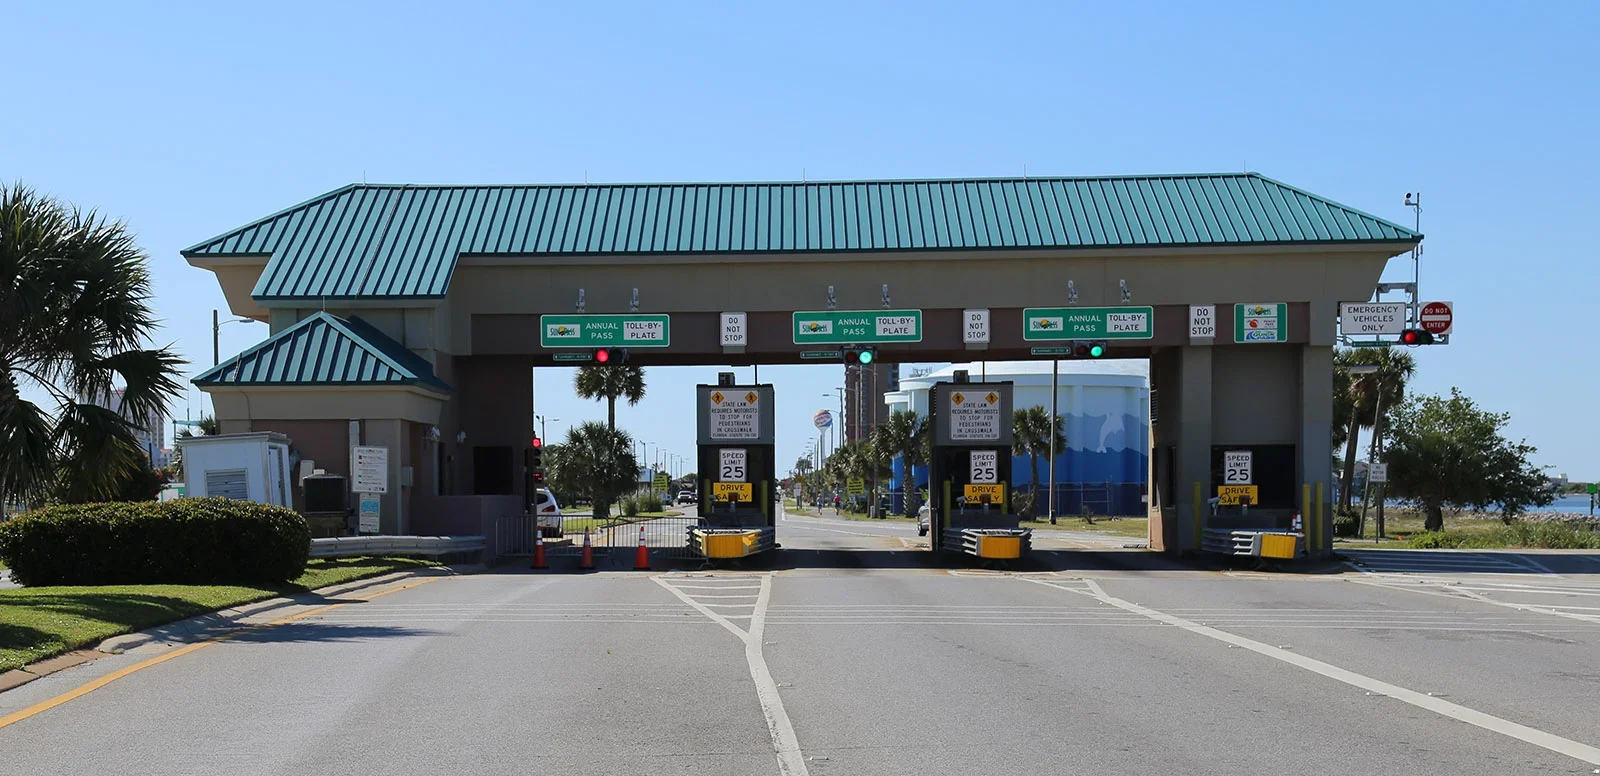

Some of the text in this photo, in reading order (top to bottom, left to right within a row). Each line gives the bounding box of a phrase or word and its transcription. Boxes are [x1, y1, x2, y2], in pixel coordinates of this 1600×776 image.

[1192, 327, 1213, 335] STOP
[723, 466, 744, 478] 25
[974, 468, 994, 480] 25
[1227, 469, 1249, 481] 25
